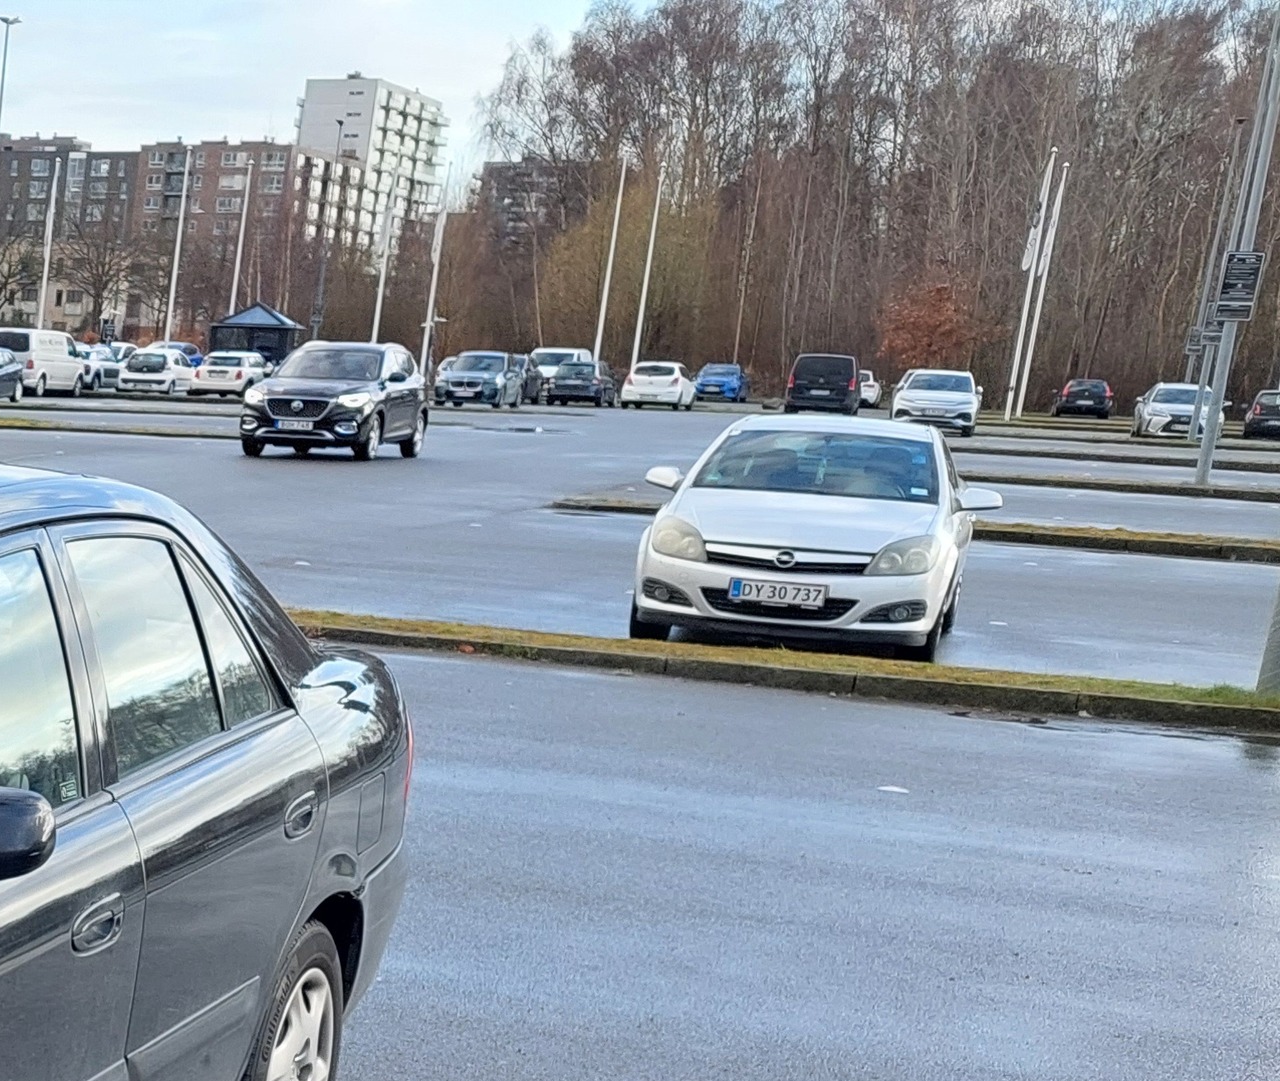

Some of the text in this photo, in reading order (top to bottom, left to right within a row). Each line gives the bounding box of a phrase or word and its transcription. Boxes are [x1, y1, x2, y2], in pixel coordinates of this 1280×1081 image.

[742, 583, 822, 603] DY 30 737
